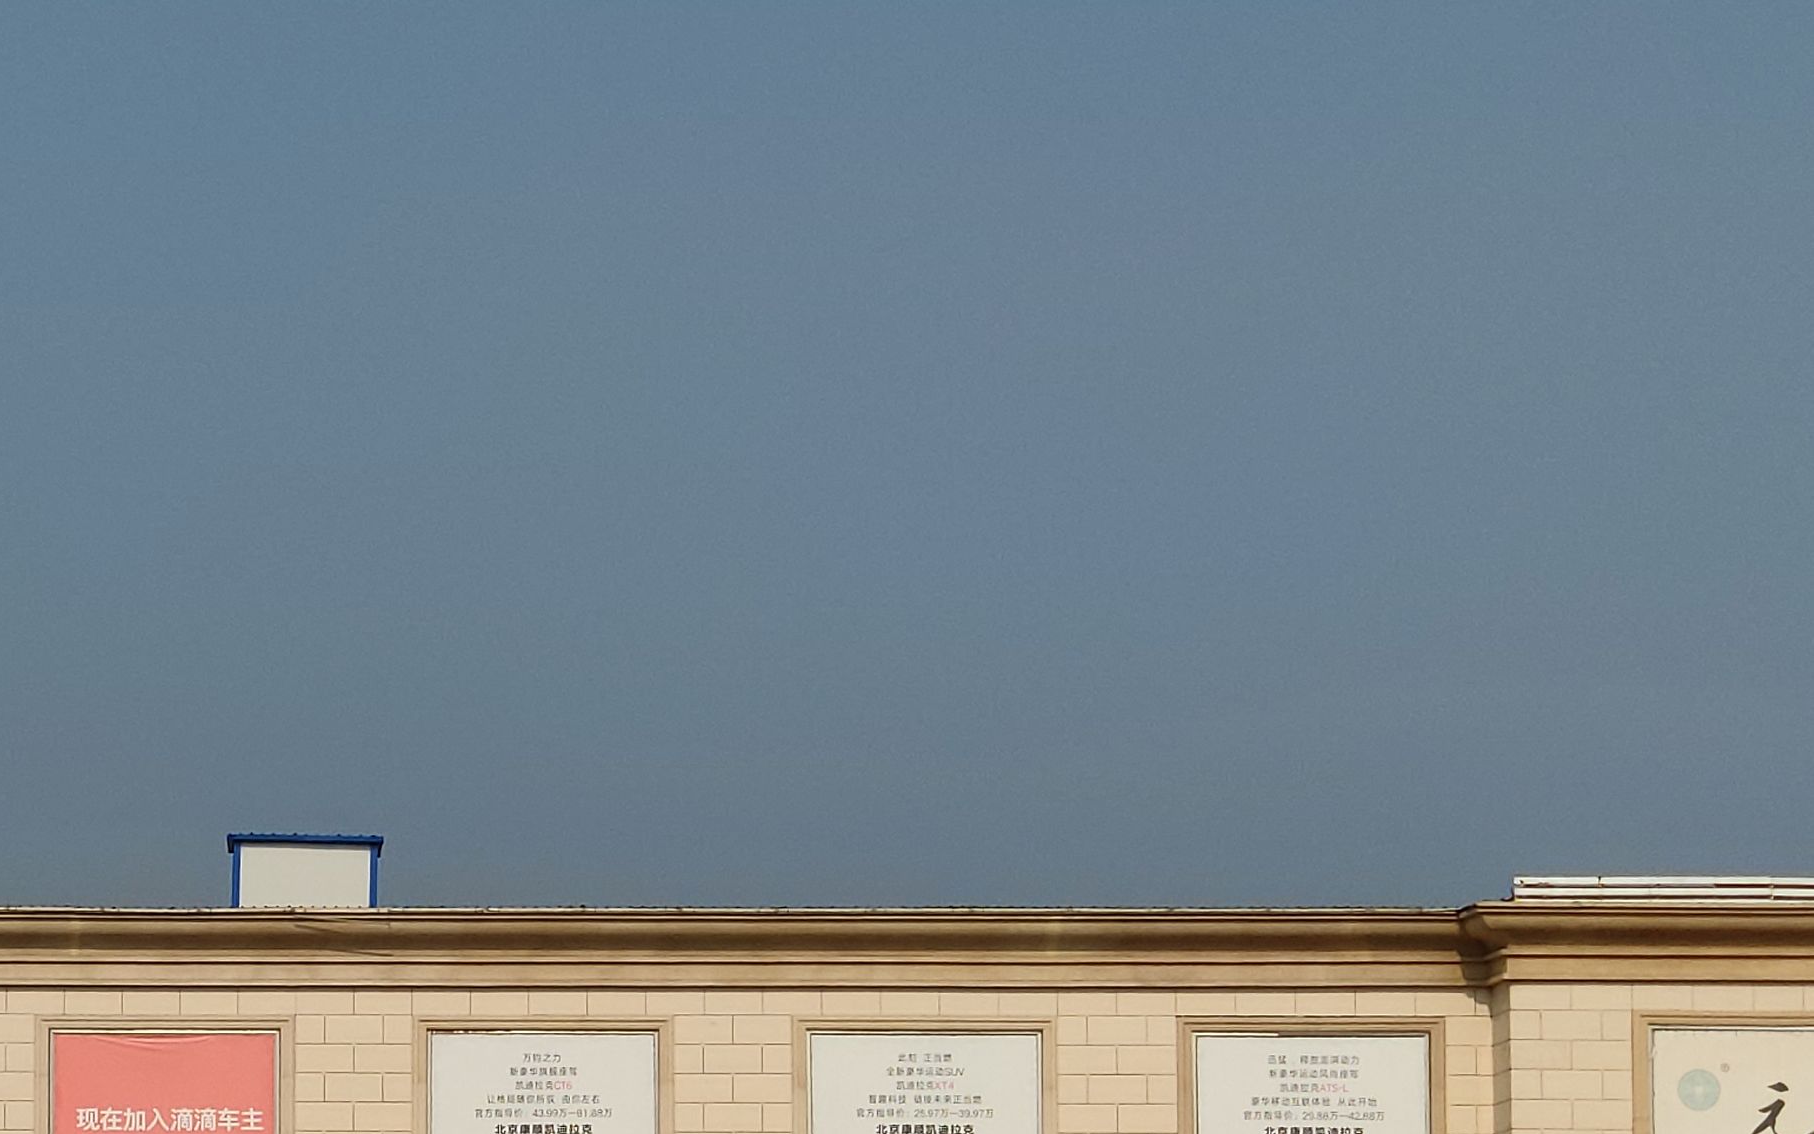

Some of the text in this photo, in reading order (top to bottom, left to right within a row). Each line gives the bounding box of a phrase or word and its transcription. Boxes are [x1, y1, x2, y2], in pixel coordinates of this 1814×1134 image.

[76, 1107, 265, 1132] 现在加入滴滴车主
[494, 1124, 593, 1134] 北京康顺凯迪拉克
